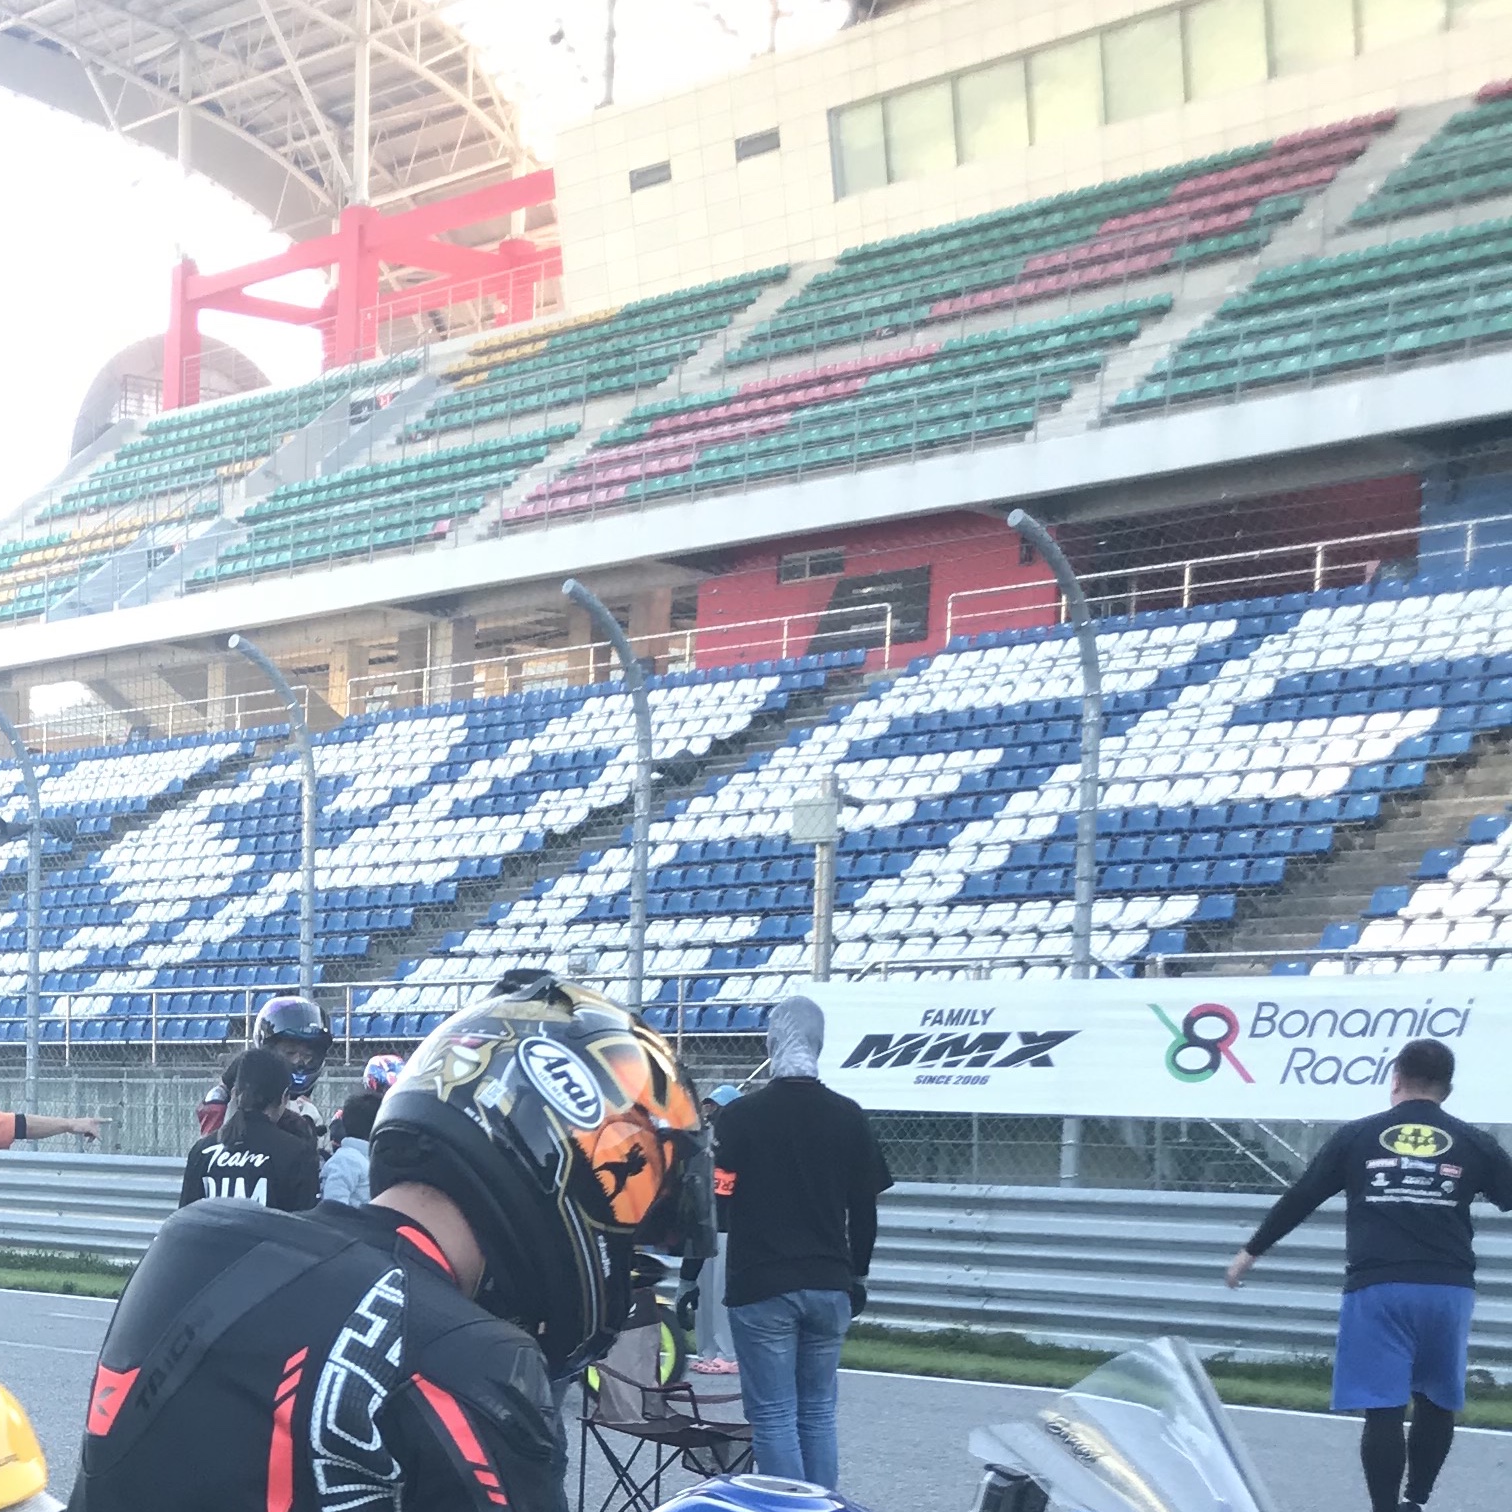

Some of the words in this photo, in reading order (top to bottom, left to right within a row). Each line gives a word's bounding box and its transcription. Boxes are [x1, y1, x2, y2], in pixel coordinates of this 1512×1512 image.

[920, 1007, 996, 1027] FAMILY
[1247, 998, 1475, 1039] Bonamici
[839, 1029, 1084, 1069] MMX
[1279, 1047, 1402, 1085] Raci
[525, 1046, 600, 1114] Arai
[913, 1074, 953, 1085] SINCE
[953, 1074, 991, 1085] 2006
[202, 1143, 270, 1173] Team
